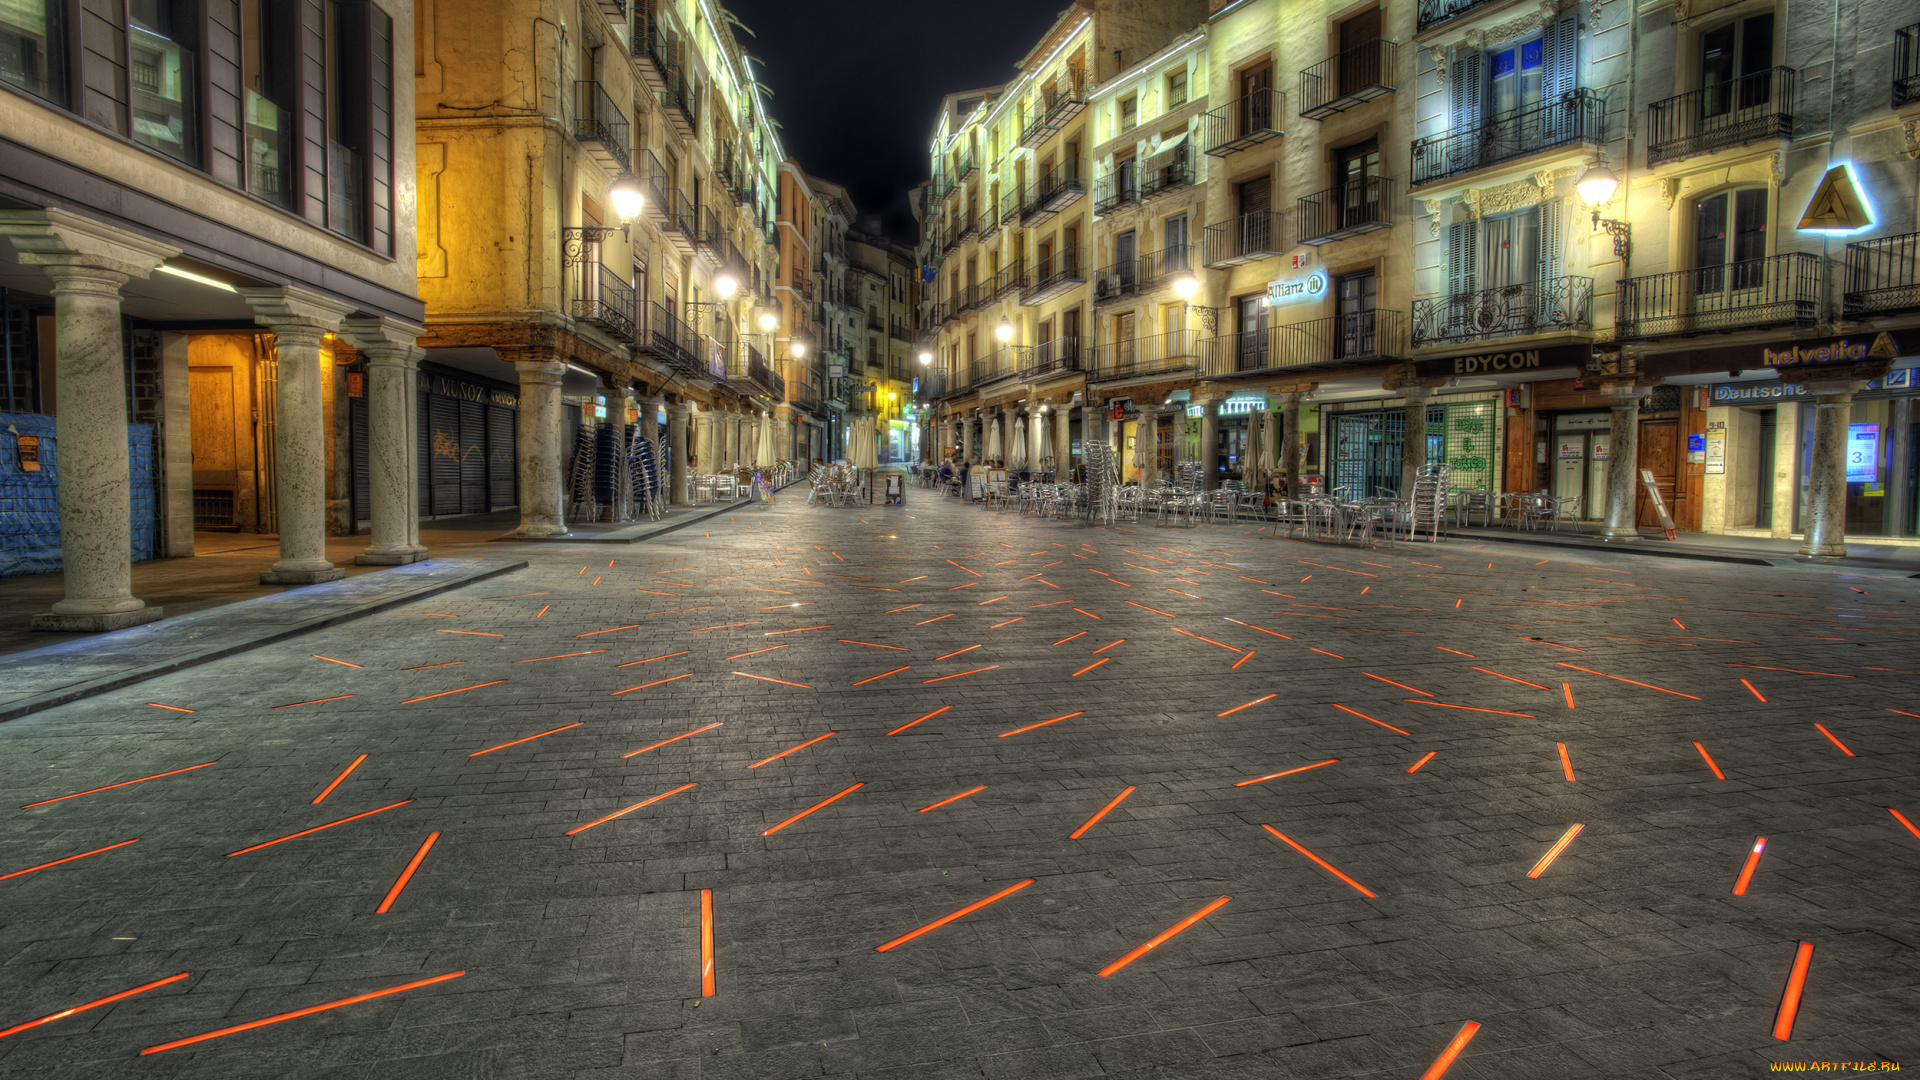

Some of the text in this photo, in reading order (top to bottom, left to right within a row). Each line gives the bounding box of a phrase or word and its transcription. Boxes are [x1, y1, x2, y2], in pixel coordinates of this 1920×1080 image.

[1267, 282, 1304, 298] Allianz
[1454, 350, 1540, 374] EDYCON
[1763, 341, 1865, 366] helvetia
[440, 377, 484, 403] MUÑOZ
[1714, 383, 1808, 401] Deutsche
[1463, 437, 1474, 453] EL
[1851, 451, 1862, 464] 3
